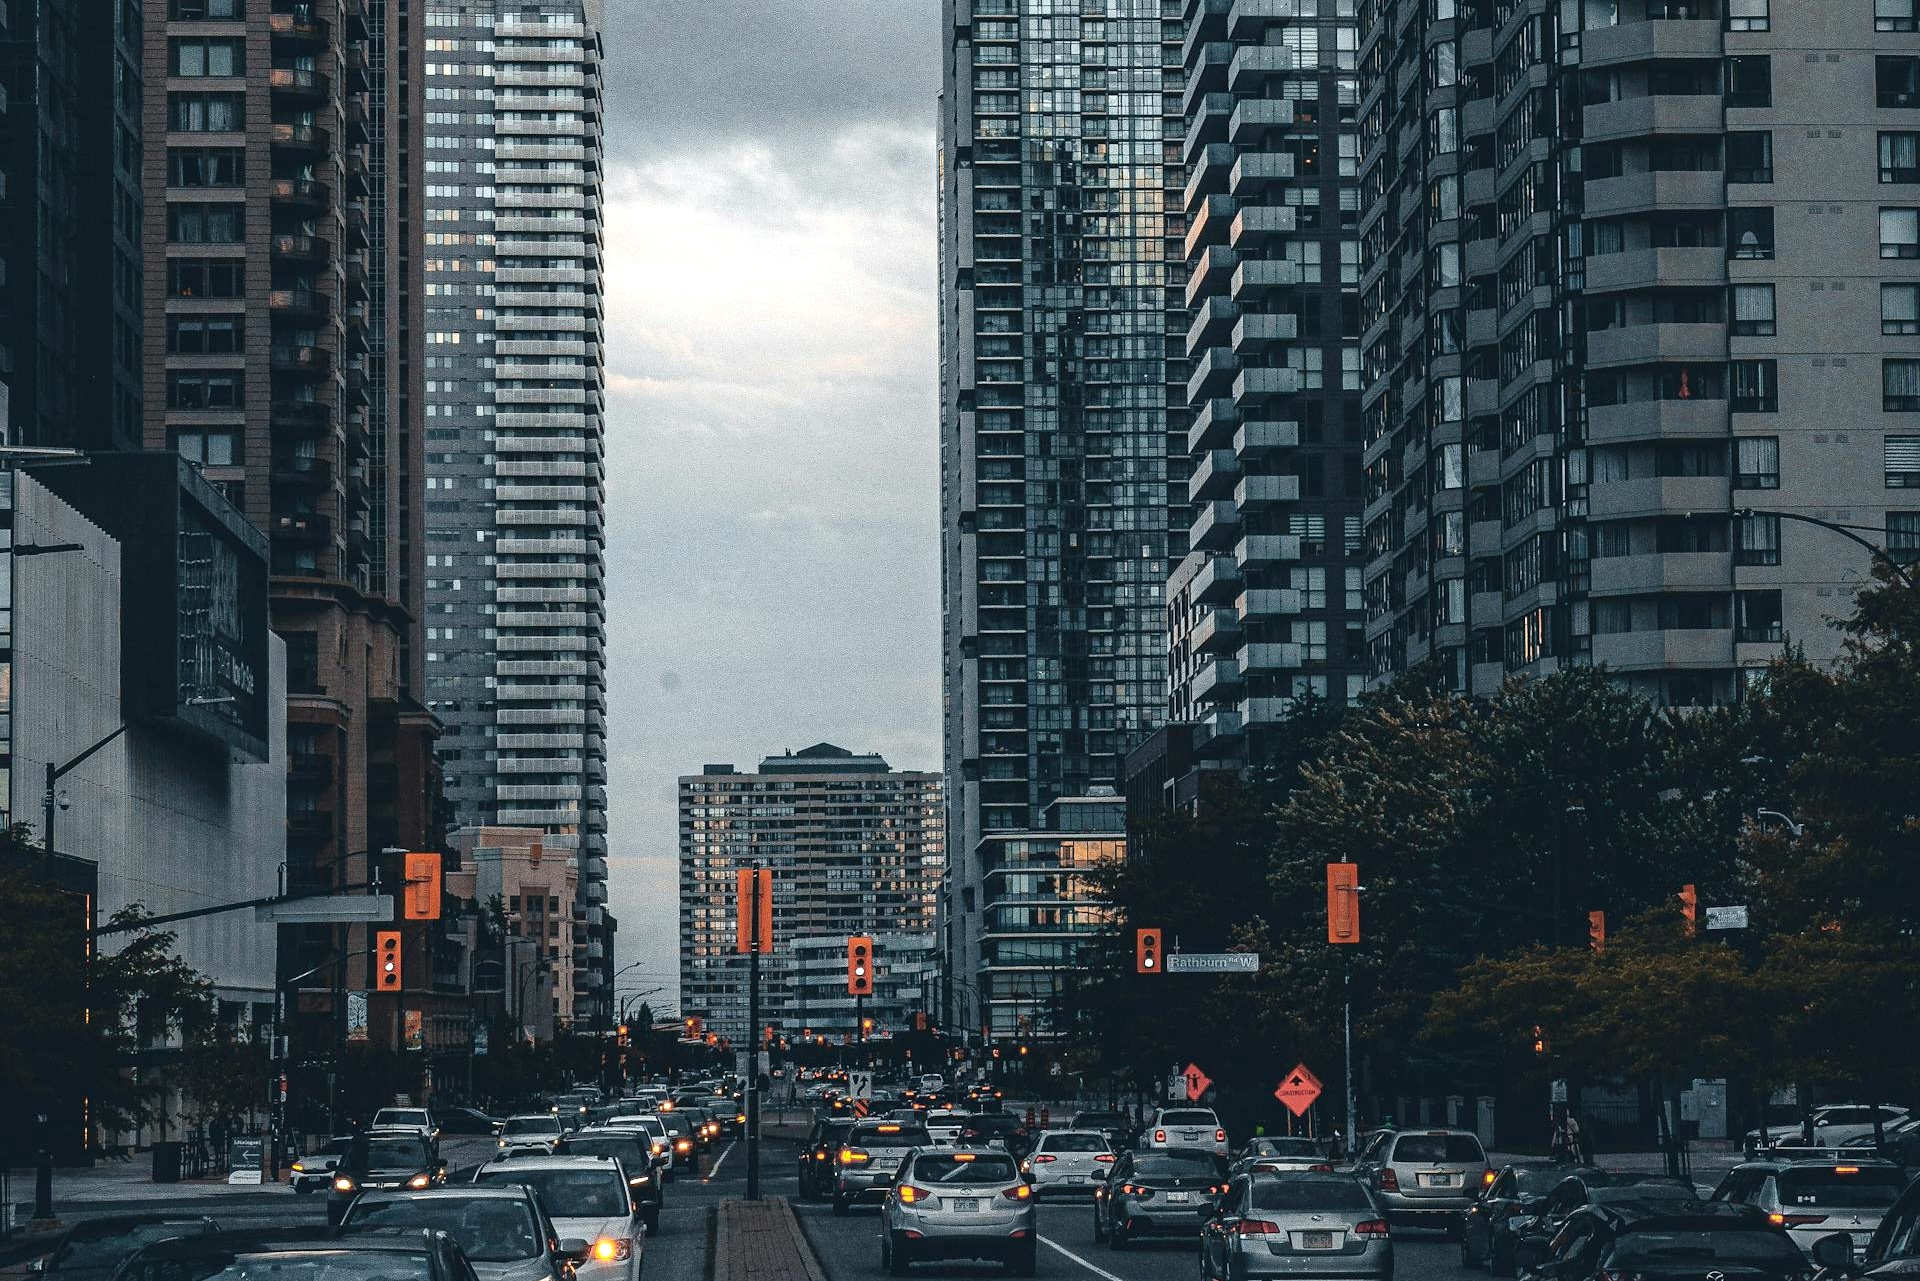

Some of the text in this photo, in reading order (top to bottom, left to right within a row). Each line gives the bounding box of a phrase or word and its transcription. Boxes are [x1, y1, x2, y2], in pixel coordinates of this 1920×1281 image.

[1171, 957, 1227, 967] Rathburn
[1240, 957, 1252, 967] W
[1279, 1089, 1316, 1097] CONSTRUCTION
